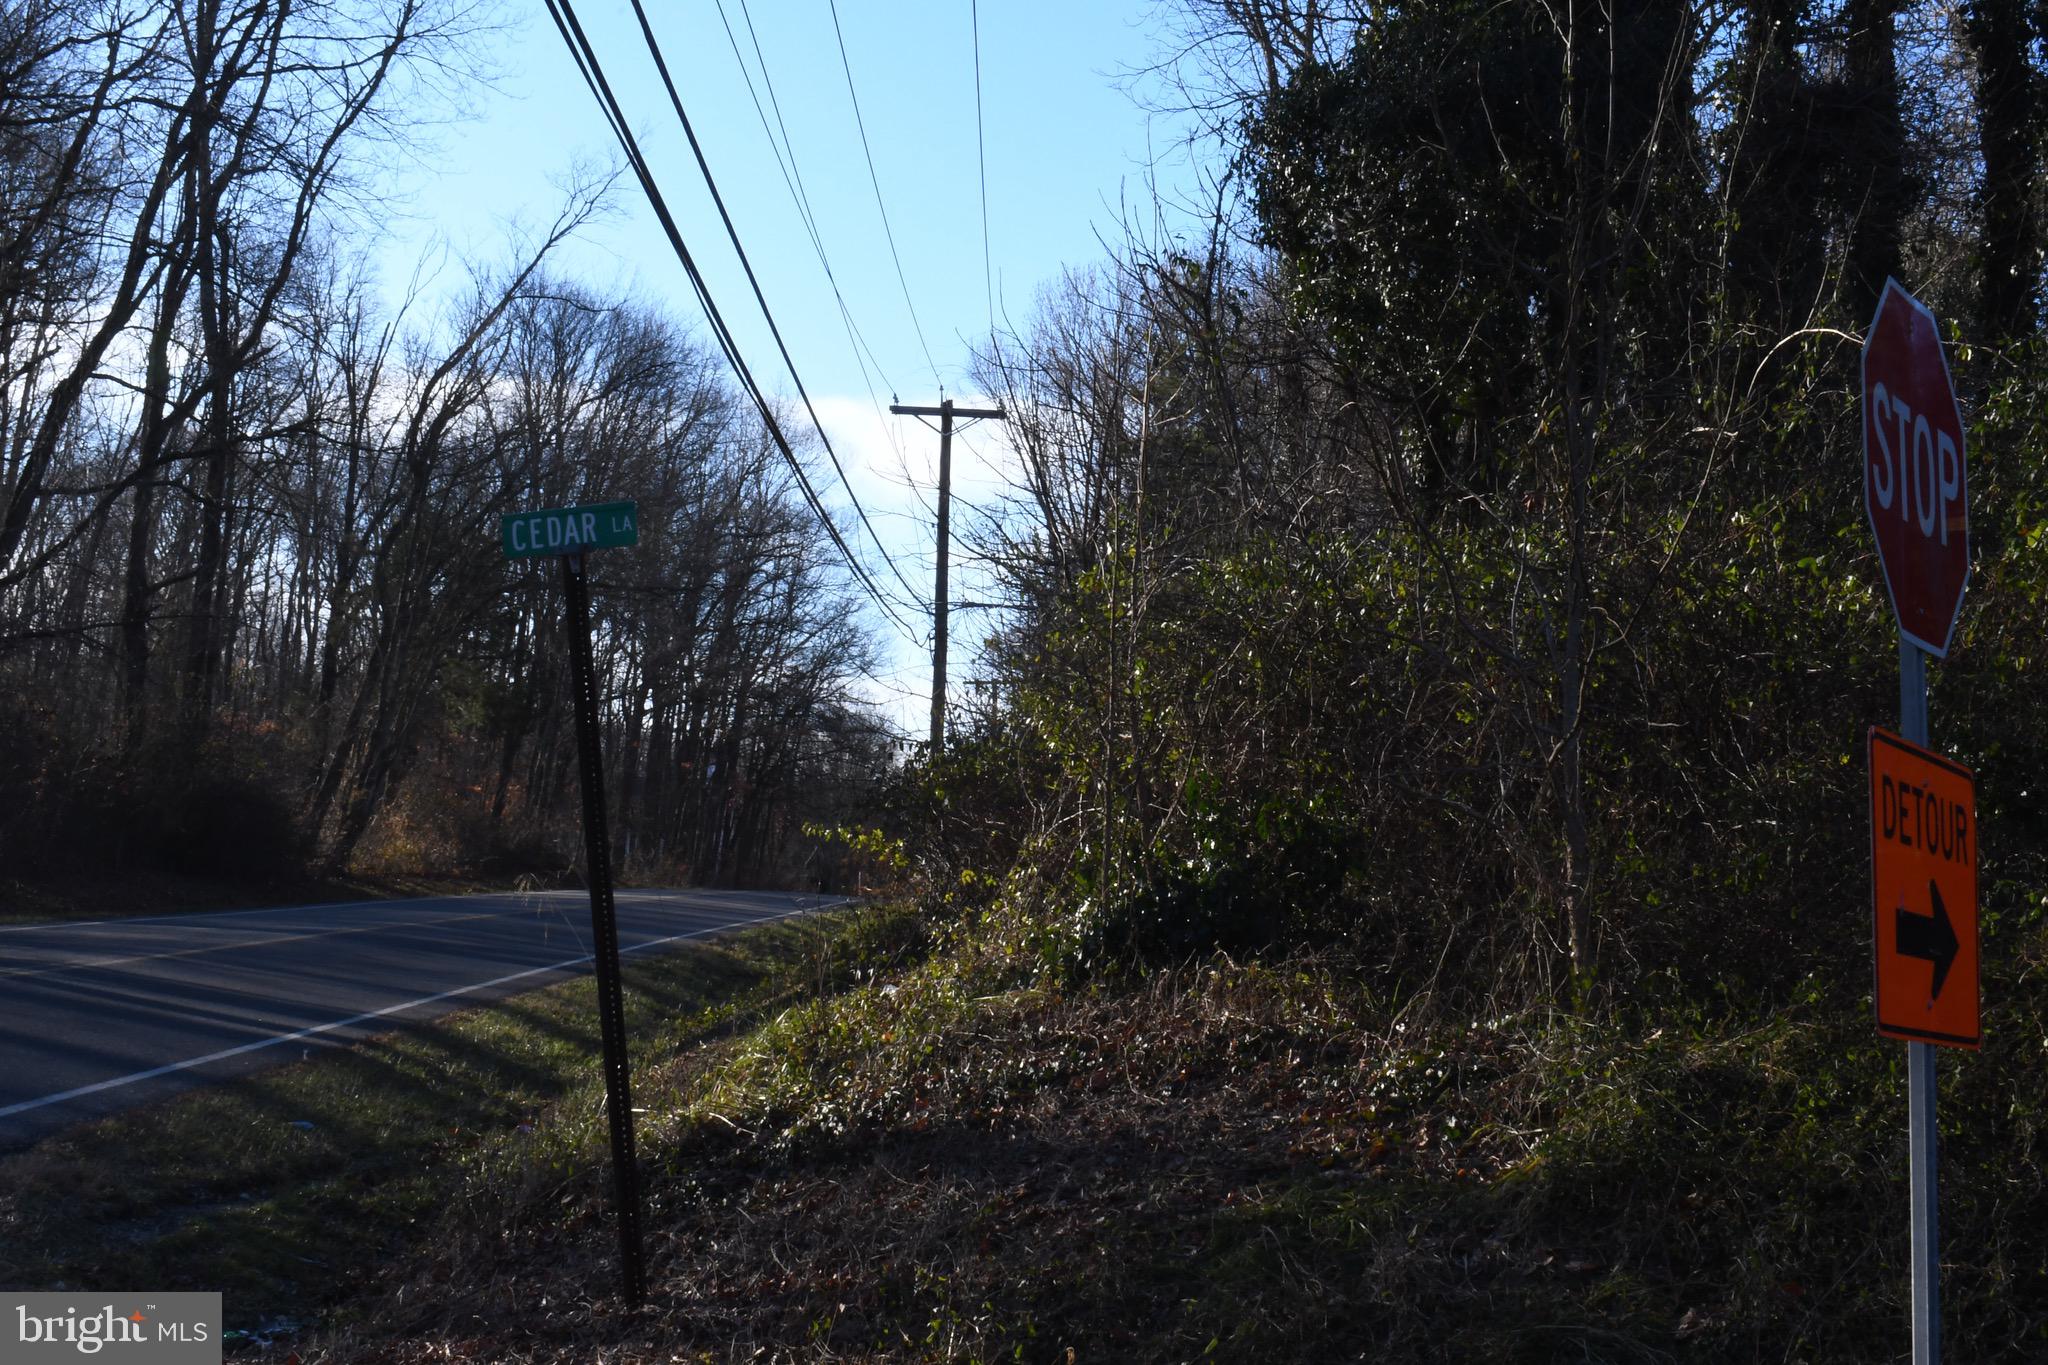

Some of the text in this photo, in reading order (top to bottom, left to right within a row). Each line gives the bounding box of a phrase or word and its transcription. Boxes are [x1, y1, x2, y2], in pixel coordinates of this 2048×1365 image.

[1872, 381, 1960, 547] STOP
[511, 512, 633, 552] CEDAR LA
[1881, 773, 1969, 866] DETOUR
